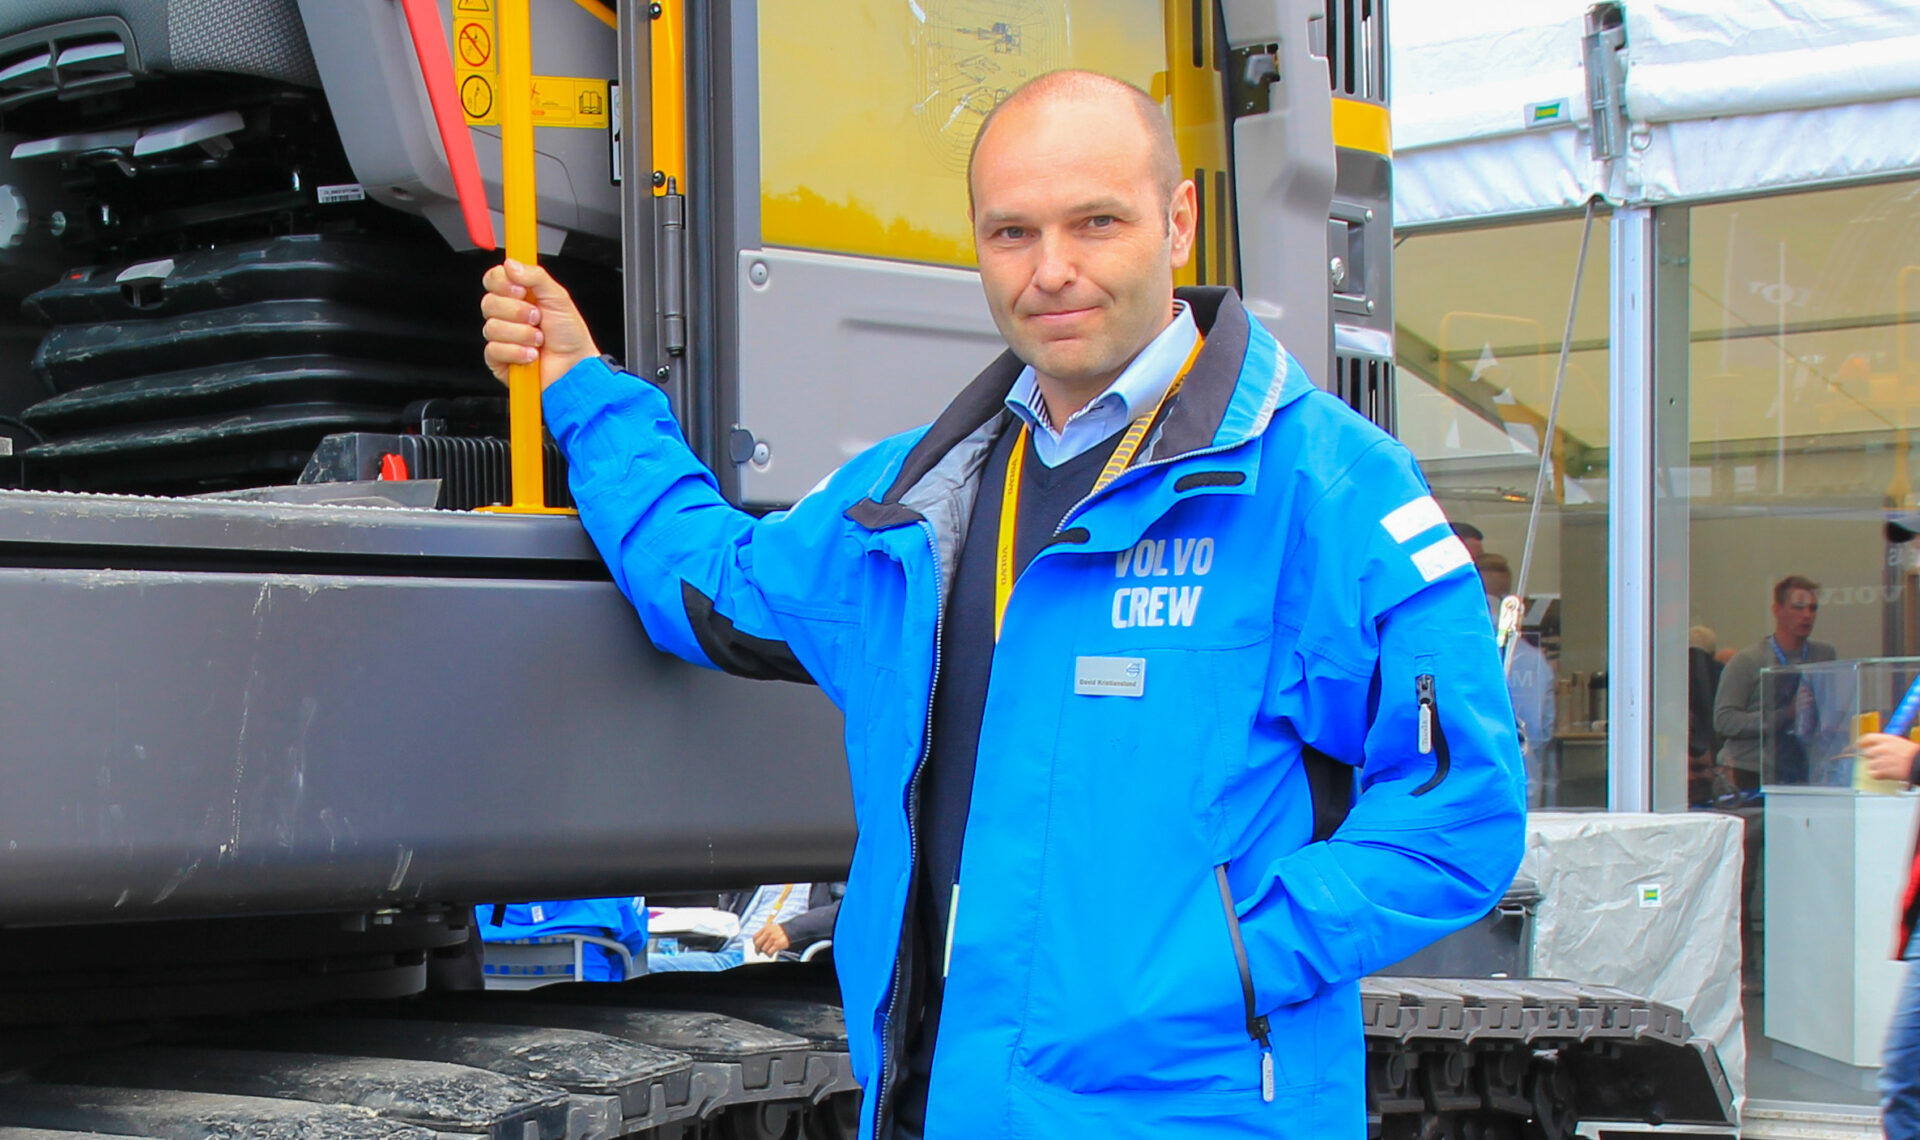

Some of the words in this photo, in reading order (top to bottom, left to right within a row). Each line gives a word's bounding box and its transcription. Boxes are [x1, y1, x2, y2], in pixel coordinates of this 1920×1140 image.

[1001, 544, 1009, 586] VOLVO
[1115, 537, 1214, 578] VOLVO
[1112, 586, 1203, 629] CREW
